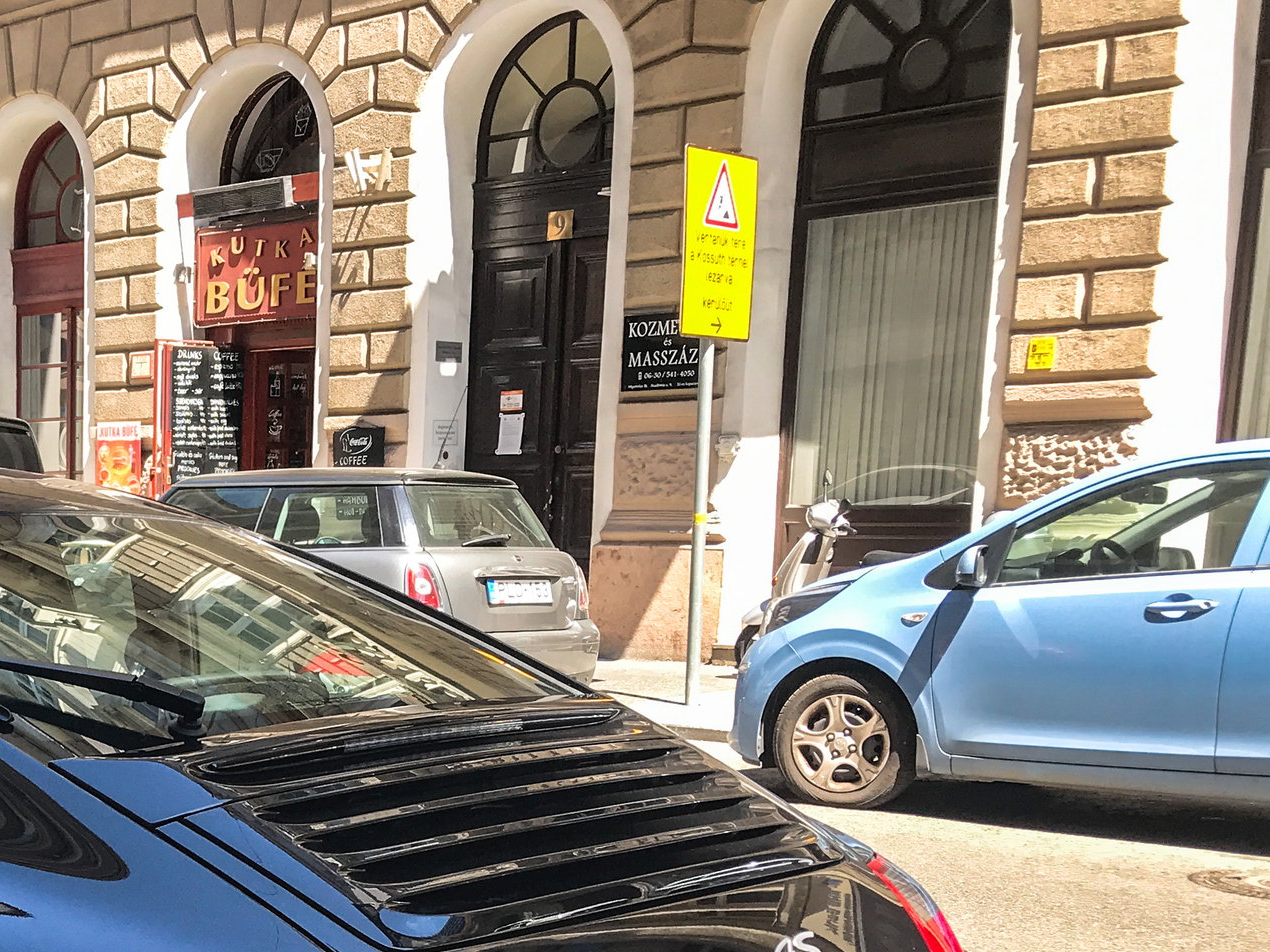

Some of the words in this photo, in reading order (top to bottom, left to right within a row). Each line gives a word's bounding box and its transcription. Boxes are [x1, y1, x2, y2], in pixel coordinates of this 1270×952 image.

[553, 213, 566, 237] 9
[210, 227, 313, 267] KUTKA
[696, 249, 726, 265] Kossuth
[663, 337, 672, 346] és
[177, 348, 203, 360] DRINKS
[213, 351, 240, 361] COFFEE
[627, 344, 699, 368] MASSZÁZ
